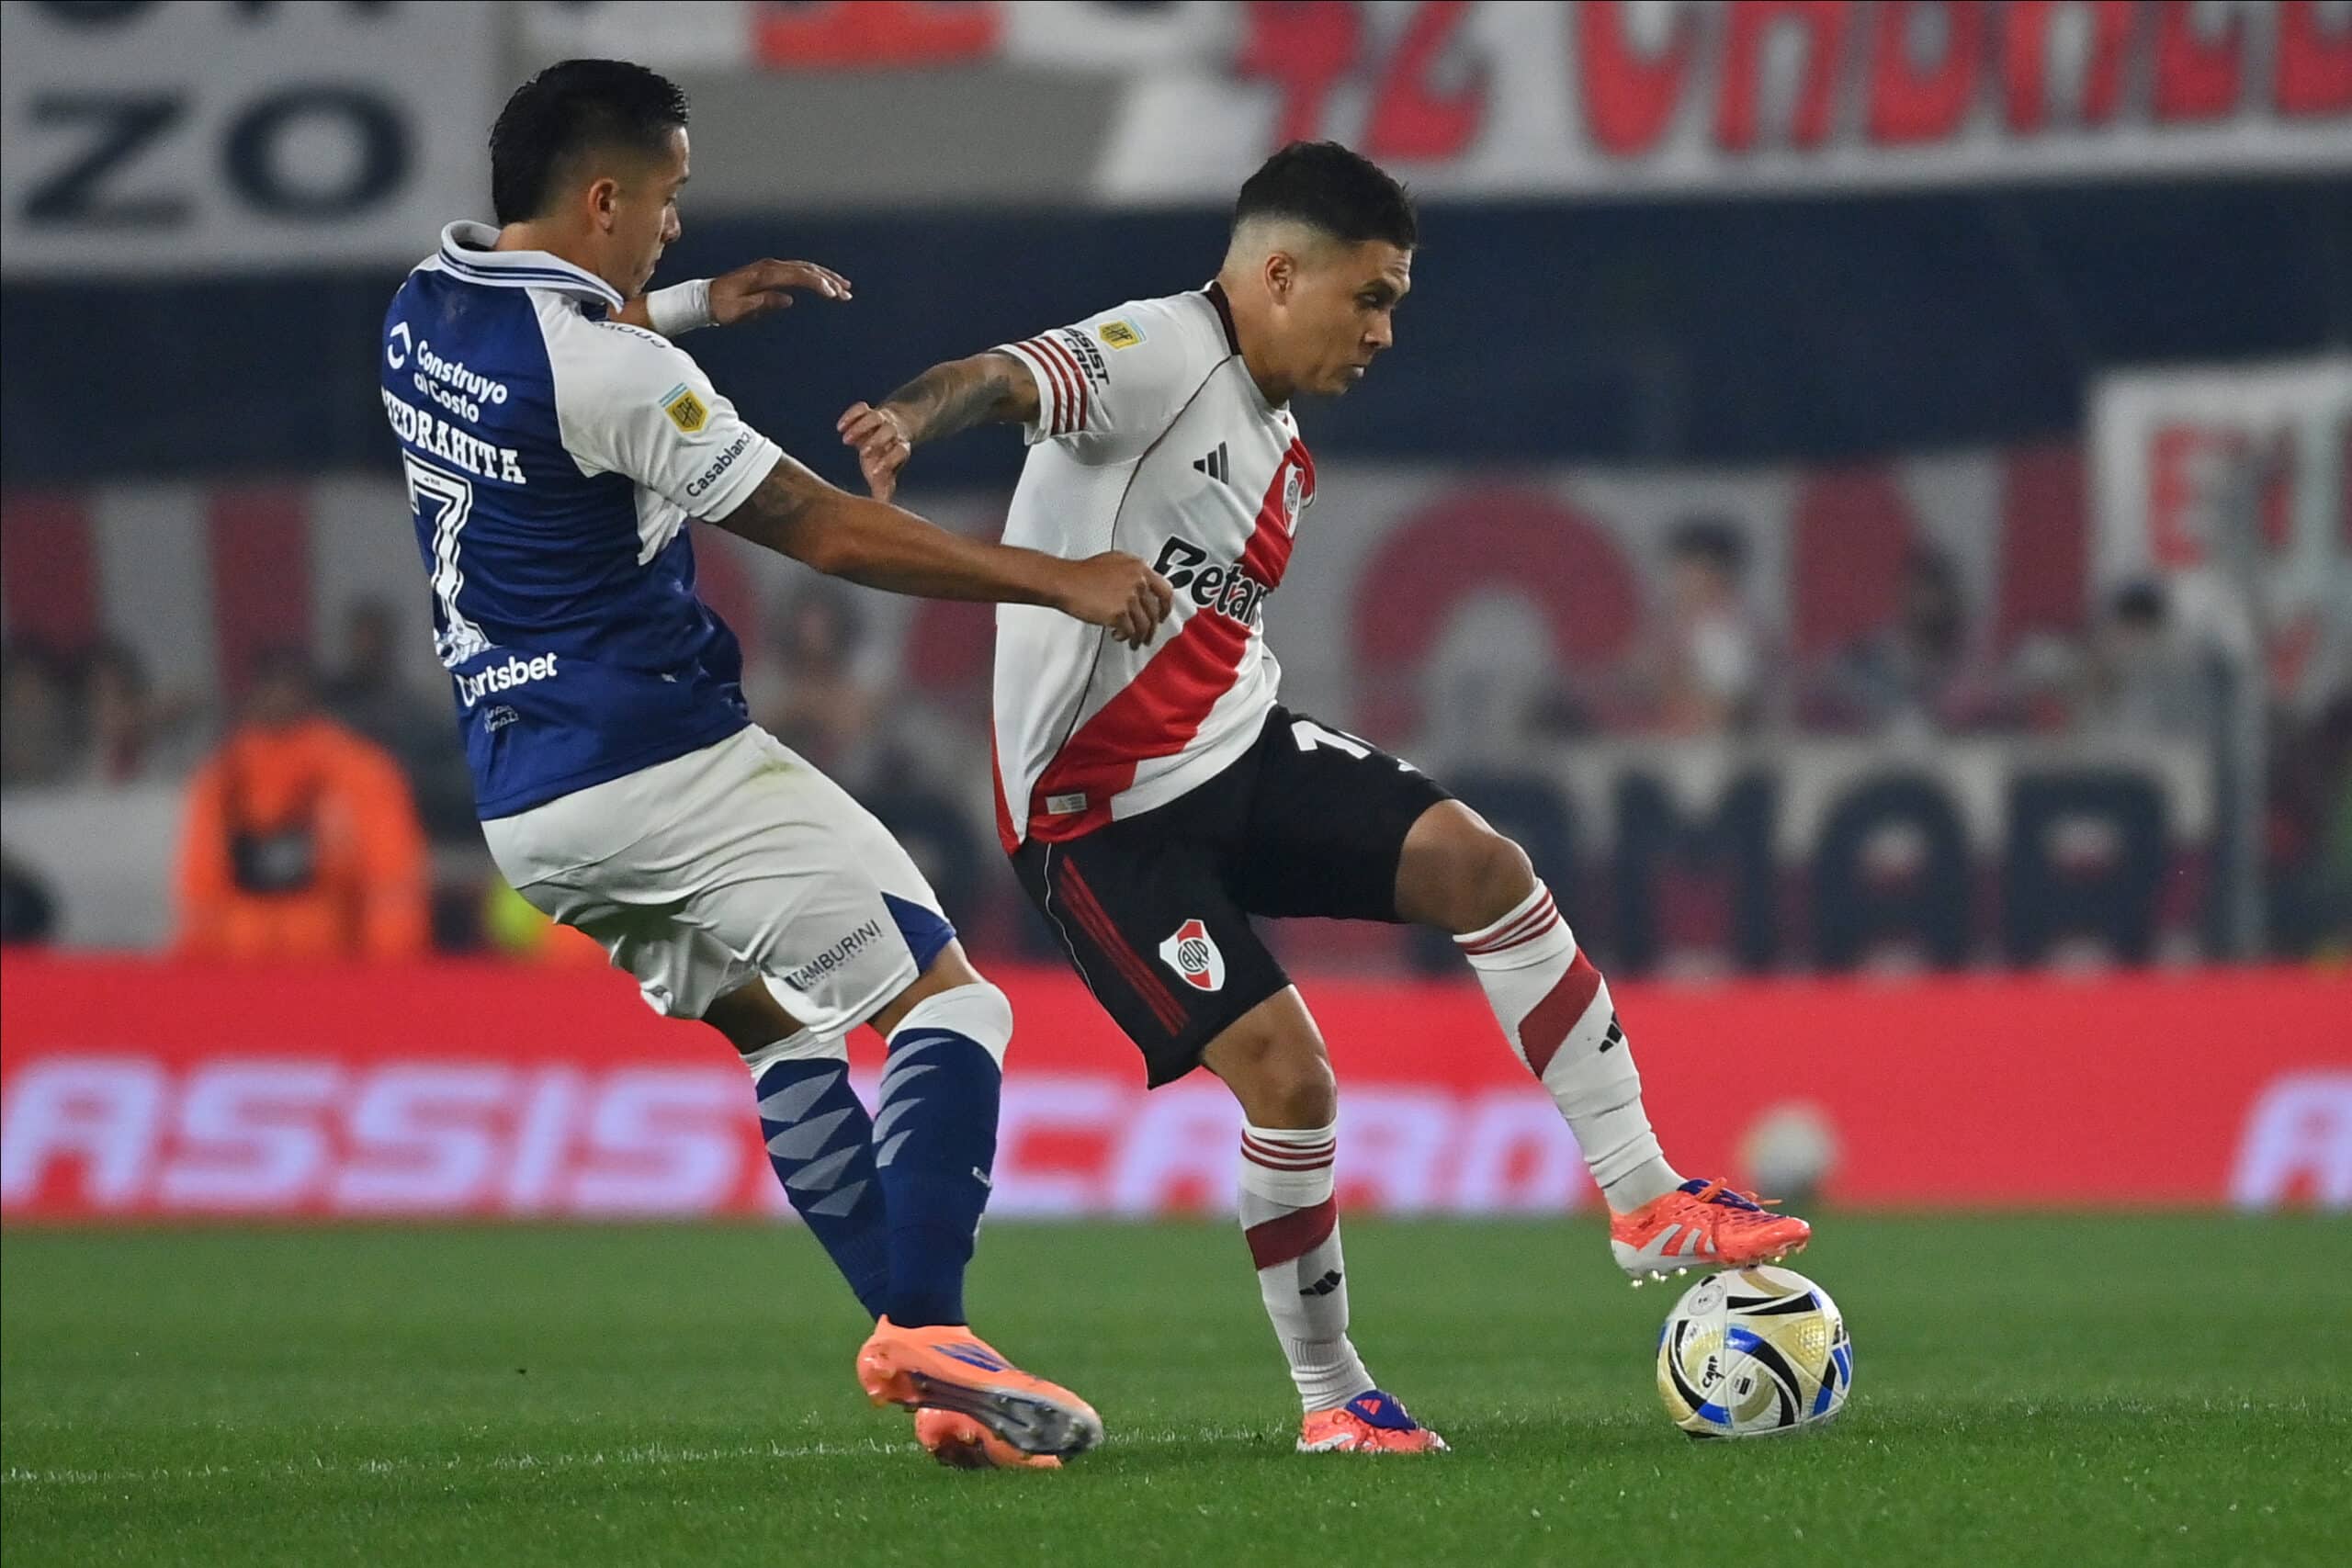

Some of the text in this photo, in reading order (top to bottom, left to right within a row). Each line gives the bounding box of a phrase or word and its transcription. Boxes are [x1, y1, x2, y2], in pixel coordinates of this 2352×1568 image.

[417, 339, 508, 404] Construyo
[1063, 328, 1110, 385] SSIST
[413, 372, 480, 423] al Costo
[381, 385, 526, 484] IEDRAHITA
[402, 447, 493, 649] 7
[791, 919, 882, 987] TAMBURINI
[0, 1056, 877, 1213] ASSIS
